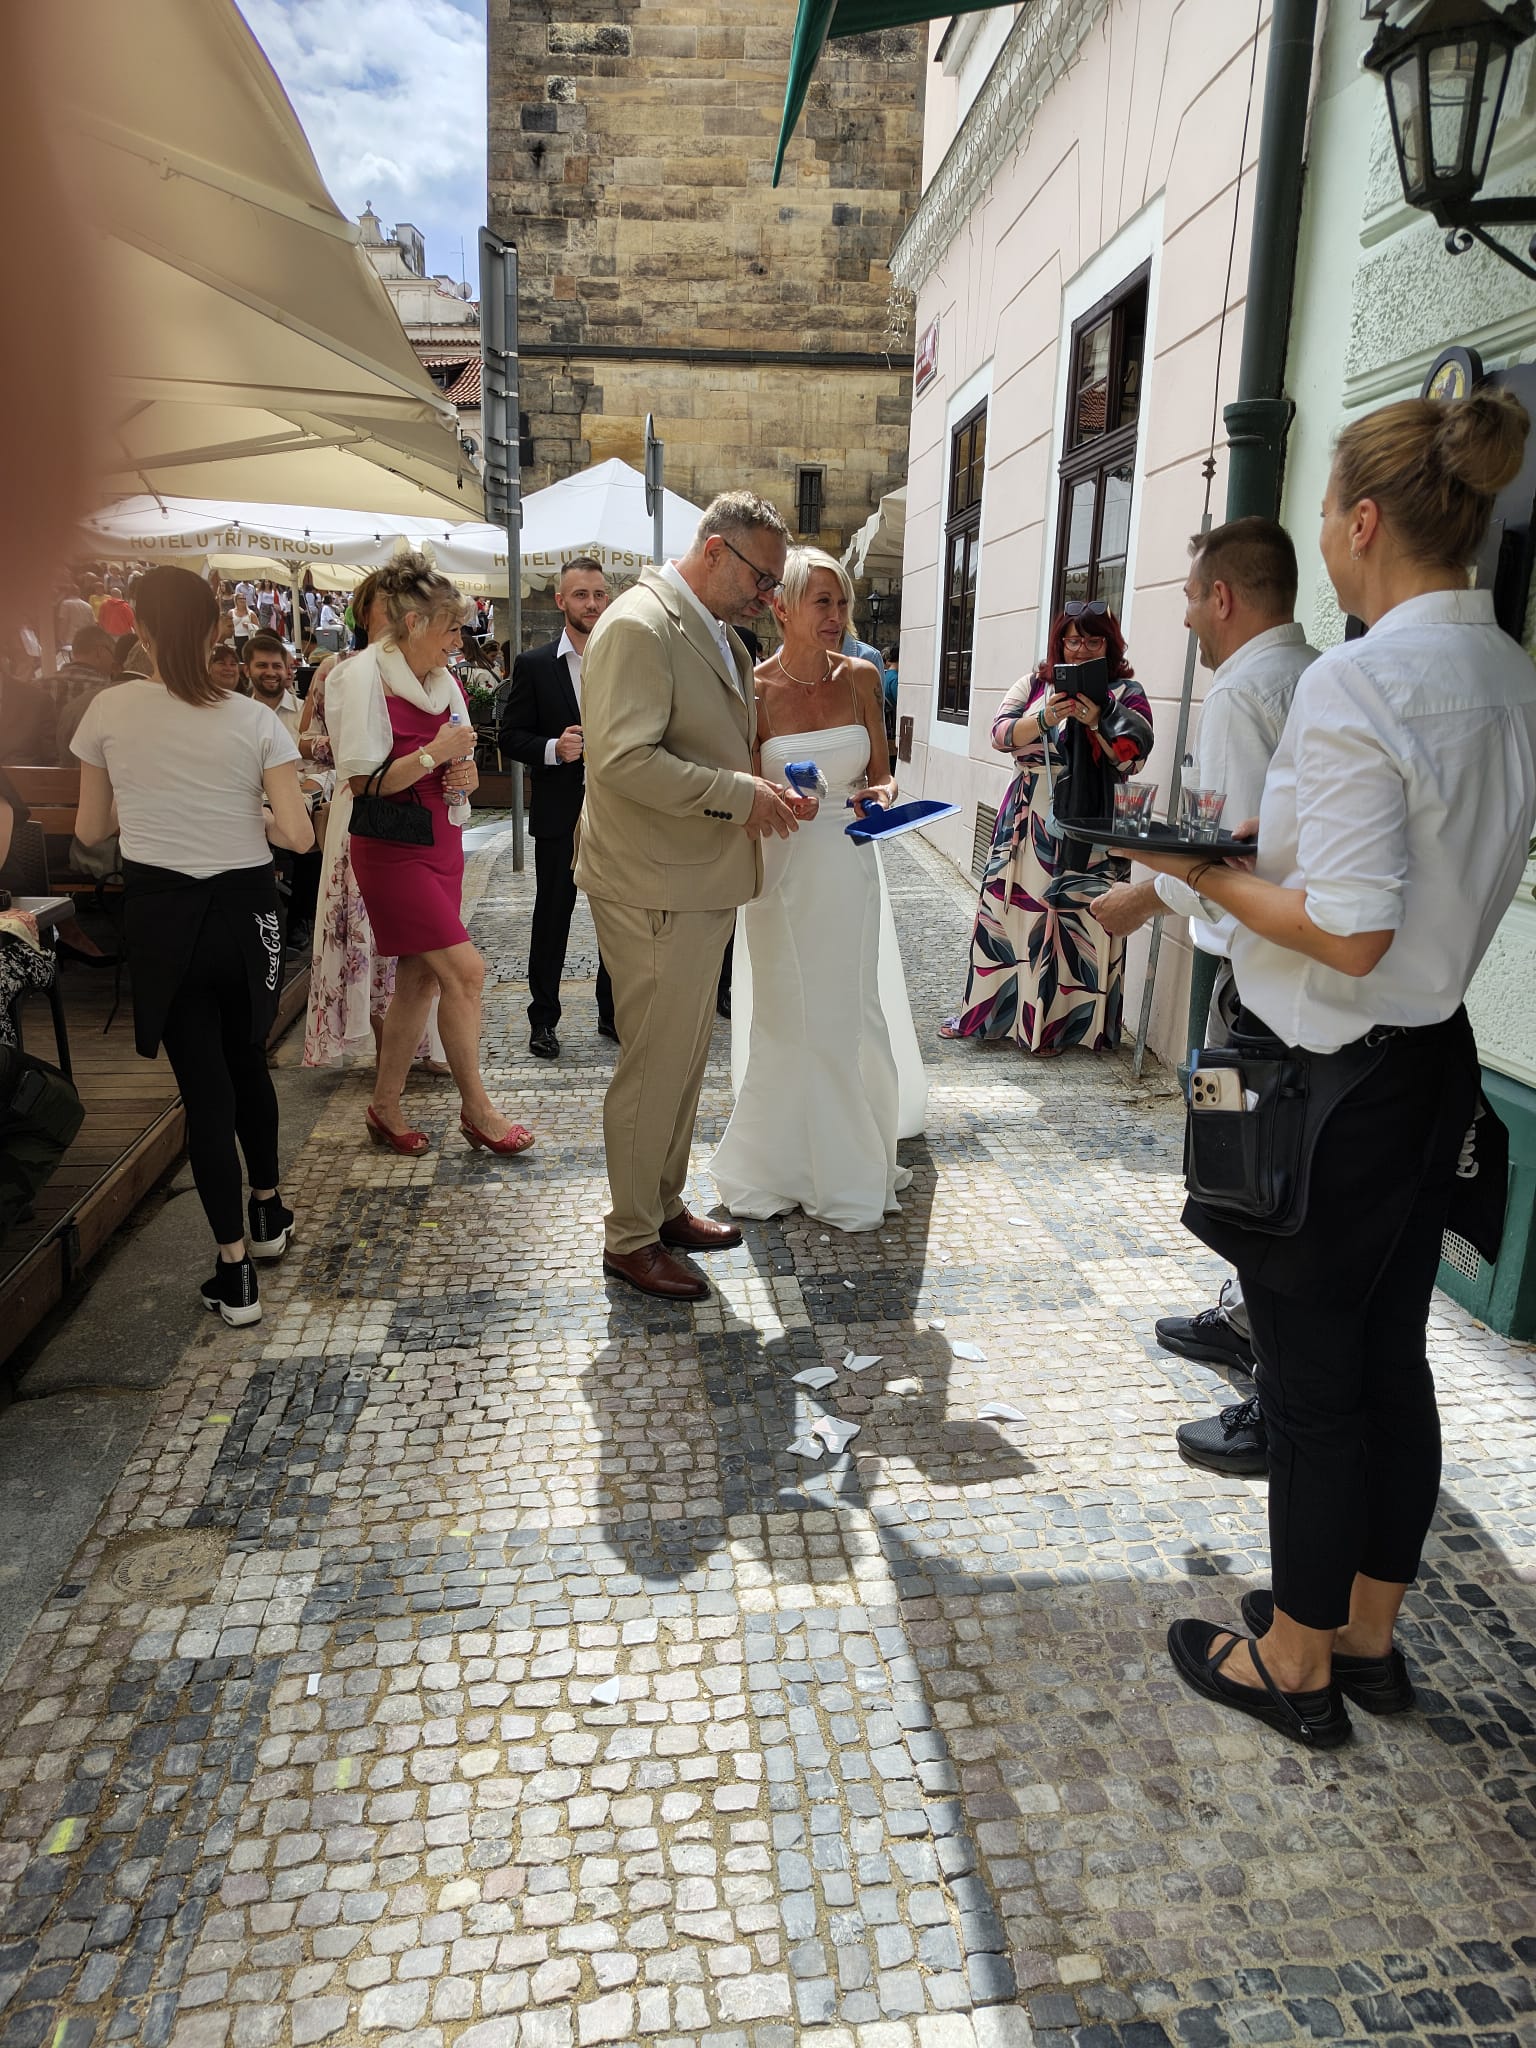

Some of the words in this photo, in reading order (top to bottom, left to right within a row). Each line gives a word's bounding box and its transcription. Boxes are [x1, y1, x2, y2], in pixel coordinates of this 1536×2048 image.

[131, 534, 192, 549] HOTEL
[197, 533, 209, 548] U
[494, 552, 556, 567] HTEL
[560, 550, 572, 564] U
